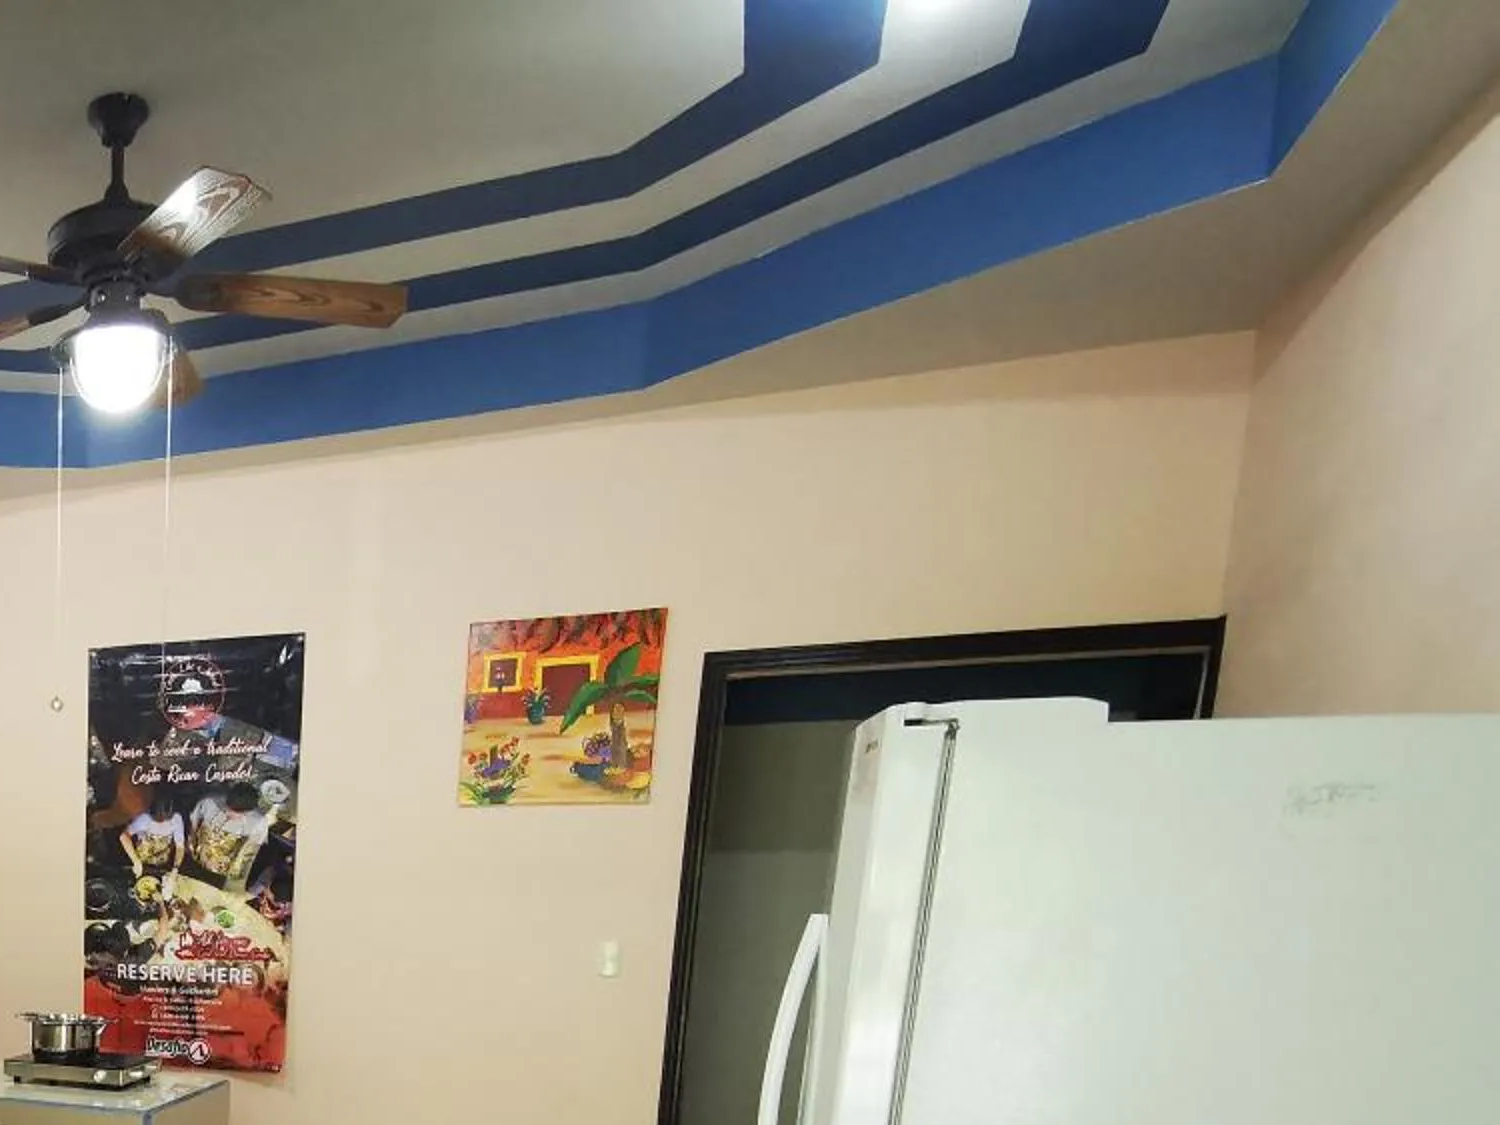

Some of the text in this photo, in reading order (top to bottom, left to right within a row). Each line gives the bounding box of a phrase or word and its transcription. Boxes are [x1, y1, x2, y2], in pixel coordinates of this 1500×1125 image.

[112, 736, 271, 762] Learn to cook a traditional
[131, 765, 162, 785] Costa
[167, 763, 201, 782] Rican
[117, 964, 253, 985] RESERVE HERE
